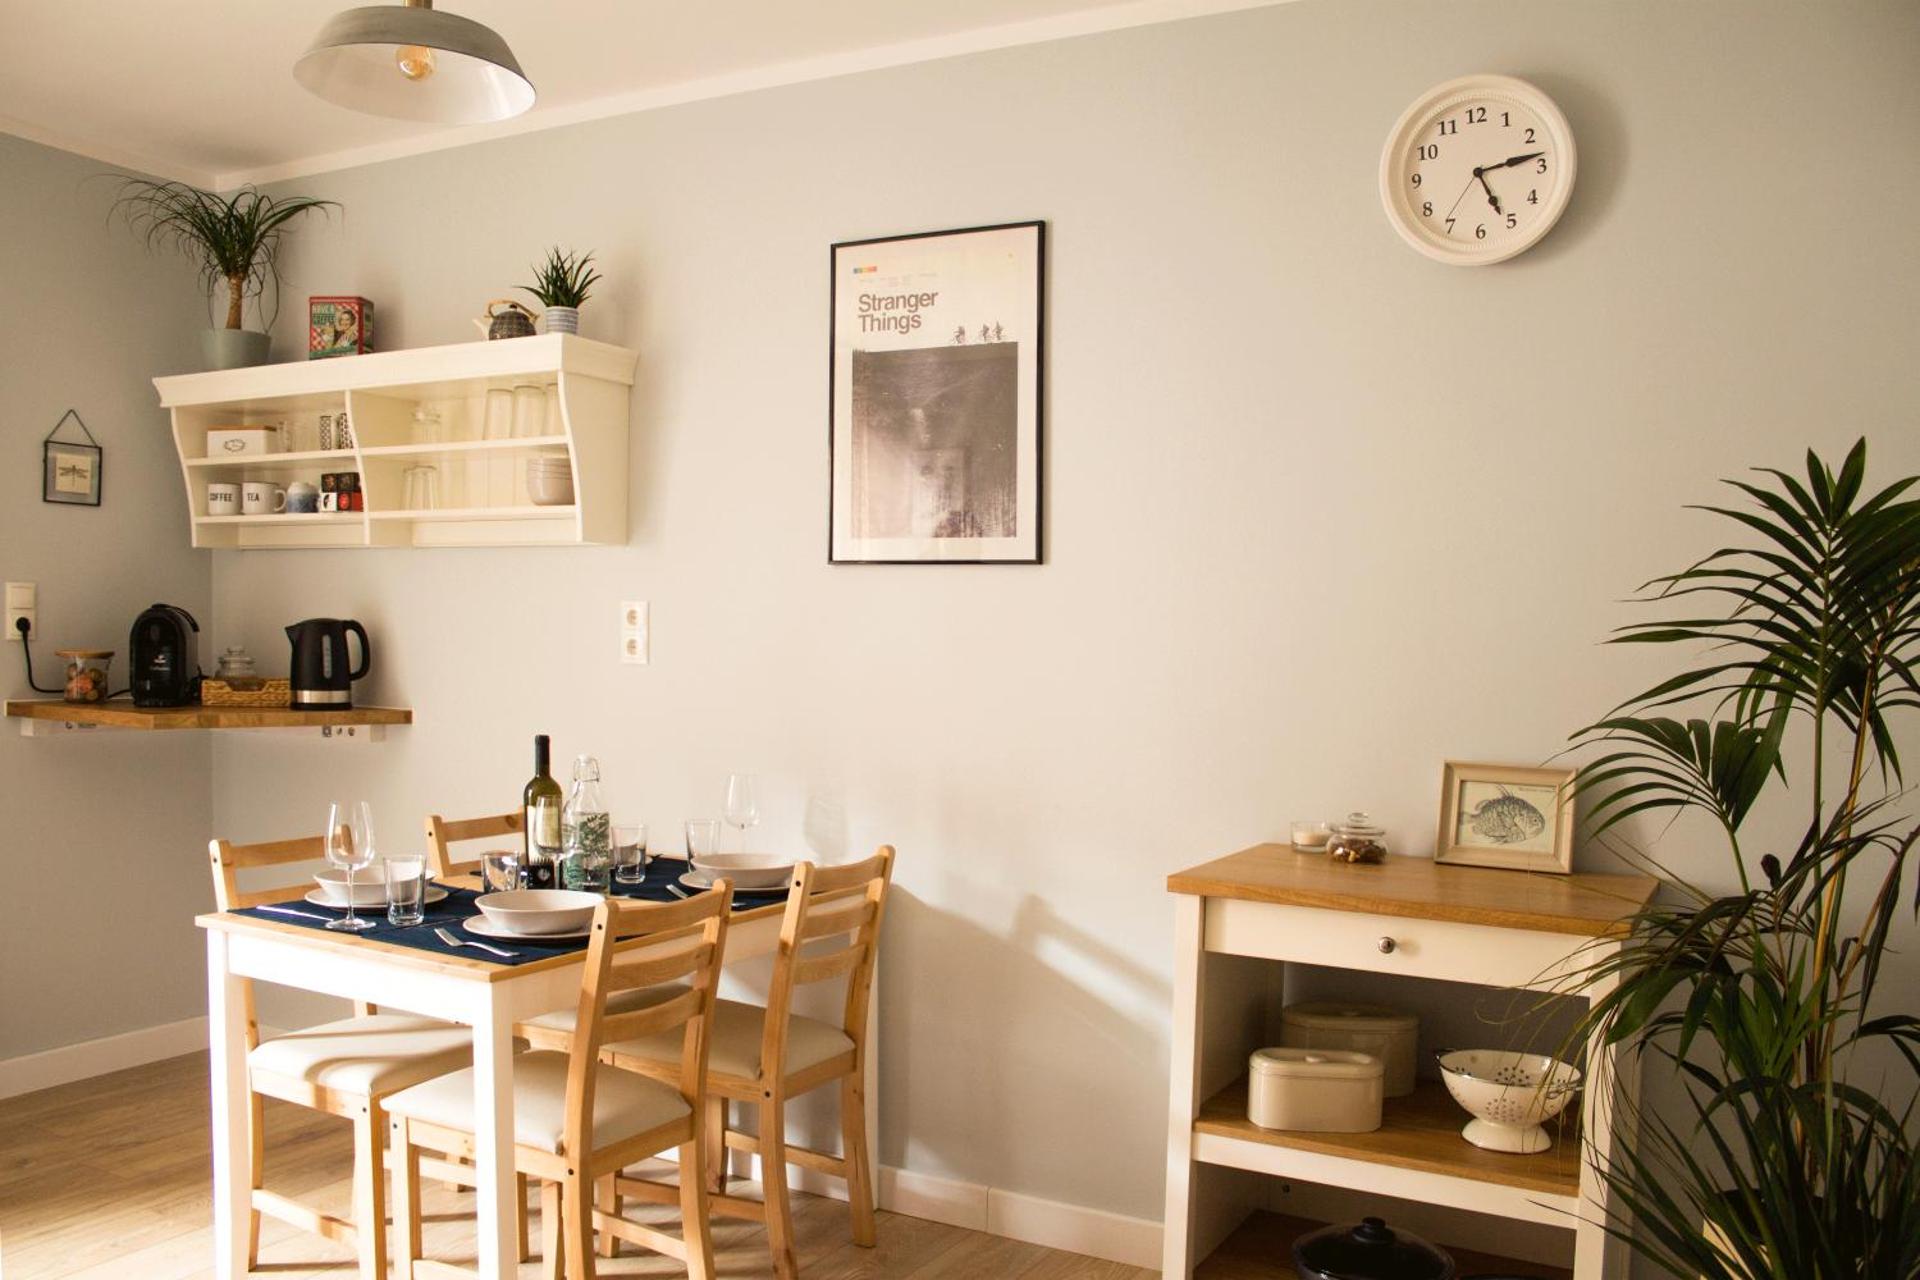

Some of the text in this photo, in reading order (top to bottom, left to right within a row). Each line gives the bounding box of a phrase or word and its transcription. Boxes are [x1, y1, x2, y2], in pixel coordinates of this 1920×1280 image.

[1465, 107, 1488, 125] 12
[1501, 112, 1511, 127] 1
[1437, 120, 1458, 136] 11
[1525, 128, 1536, 144] 2
[1417, 144, 1439, 161] 10
[1536, 159, 1547, 174] 3
[1411, 174, 1422, 189] 9
[1527, 189, 1538, 205] 4
[1423, 202, 1433, 217] 8
[1445, 218, 1456, 234] 7
[1506, 213, 1518, 229] 5
[1475, 224, 1486, 239] 6
[858, 291, 938, 313] Stranger
[858, 312, 922, 335] Things
[247, 492, 260, 502] TEA
